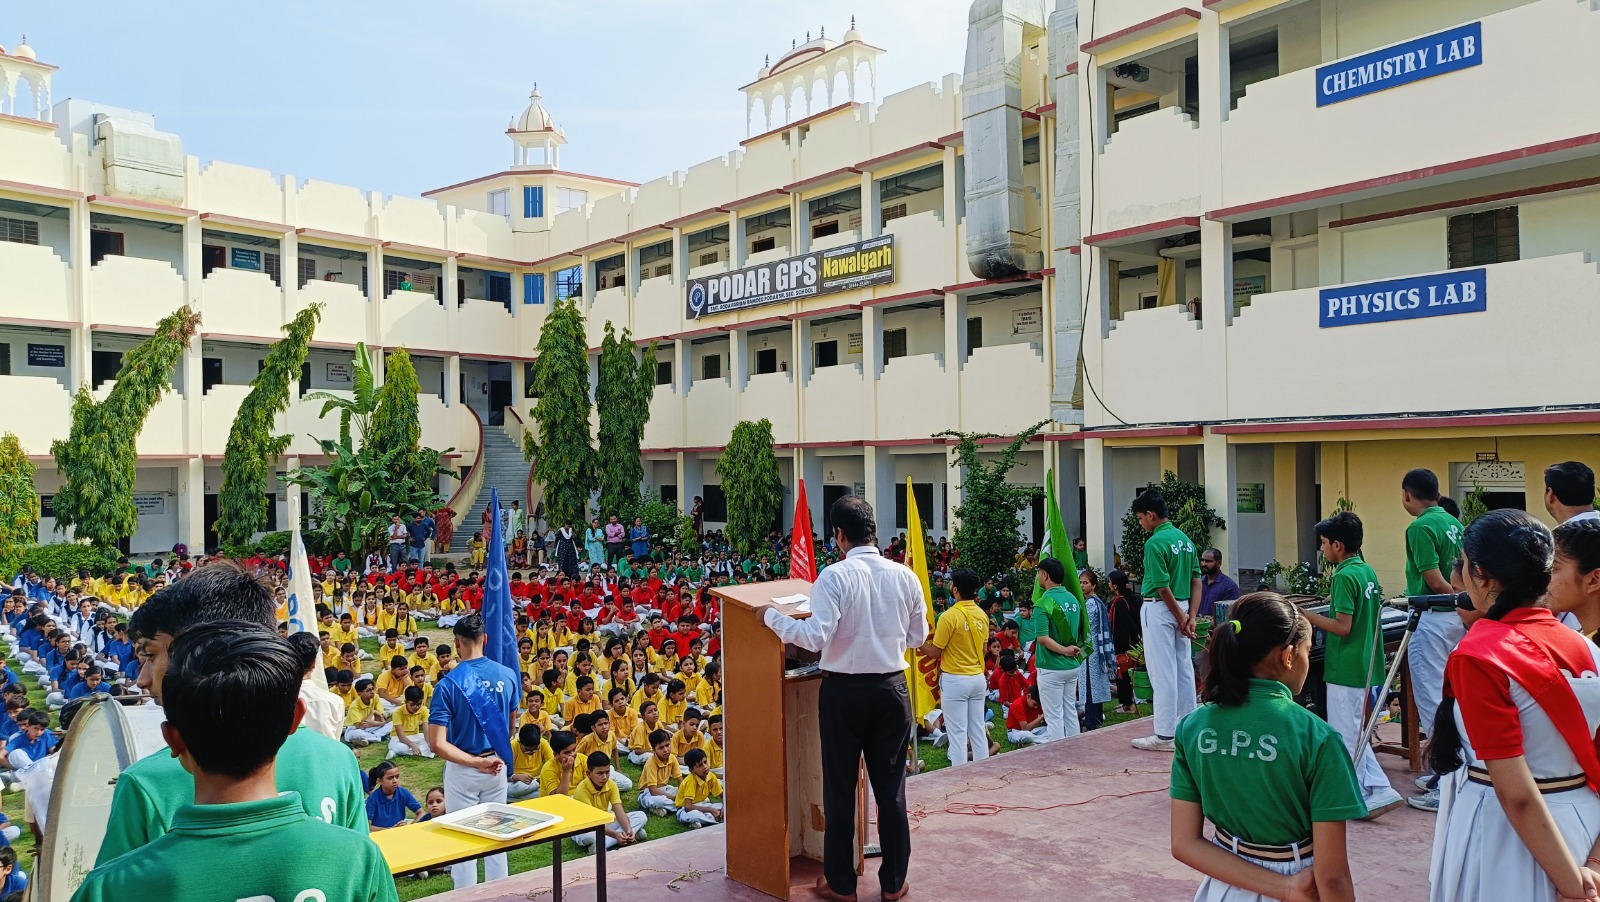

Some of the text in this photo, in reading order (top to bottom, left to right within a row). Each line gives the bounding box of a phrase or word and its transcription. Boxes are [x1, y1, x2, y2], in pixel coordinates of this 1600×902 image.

[1322, 35, 1475, 96] CHEMISTRY LAB
[823, 245, 892, 278] Nawalgarh
[707, 273, 771, 305] PODAR
[775, 256, 817, 290] GPS
[796, 288, 814, 296] SCHOOL
[1327, 281, 1477, 318] PHYSICS LAB
[481, 680, 505, 693] P.S
[1197, 727, 1278, 762] G.P.S
